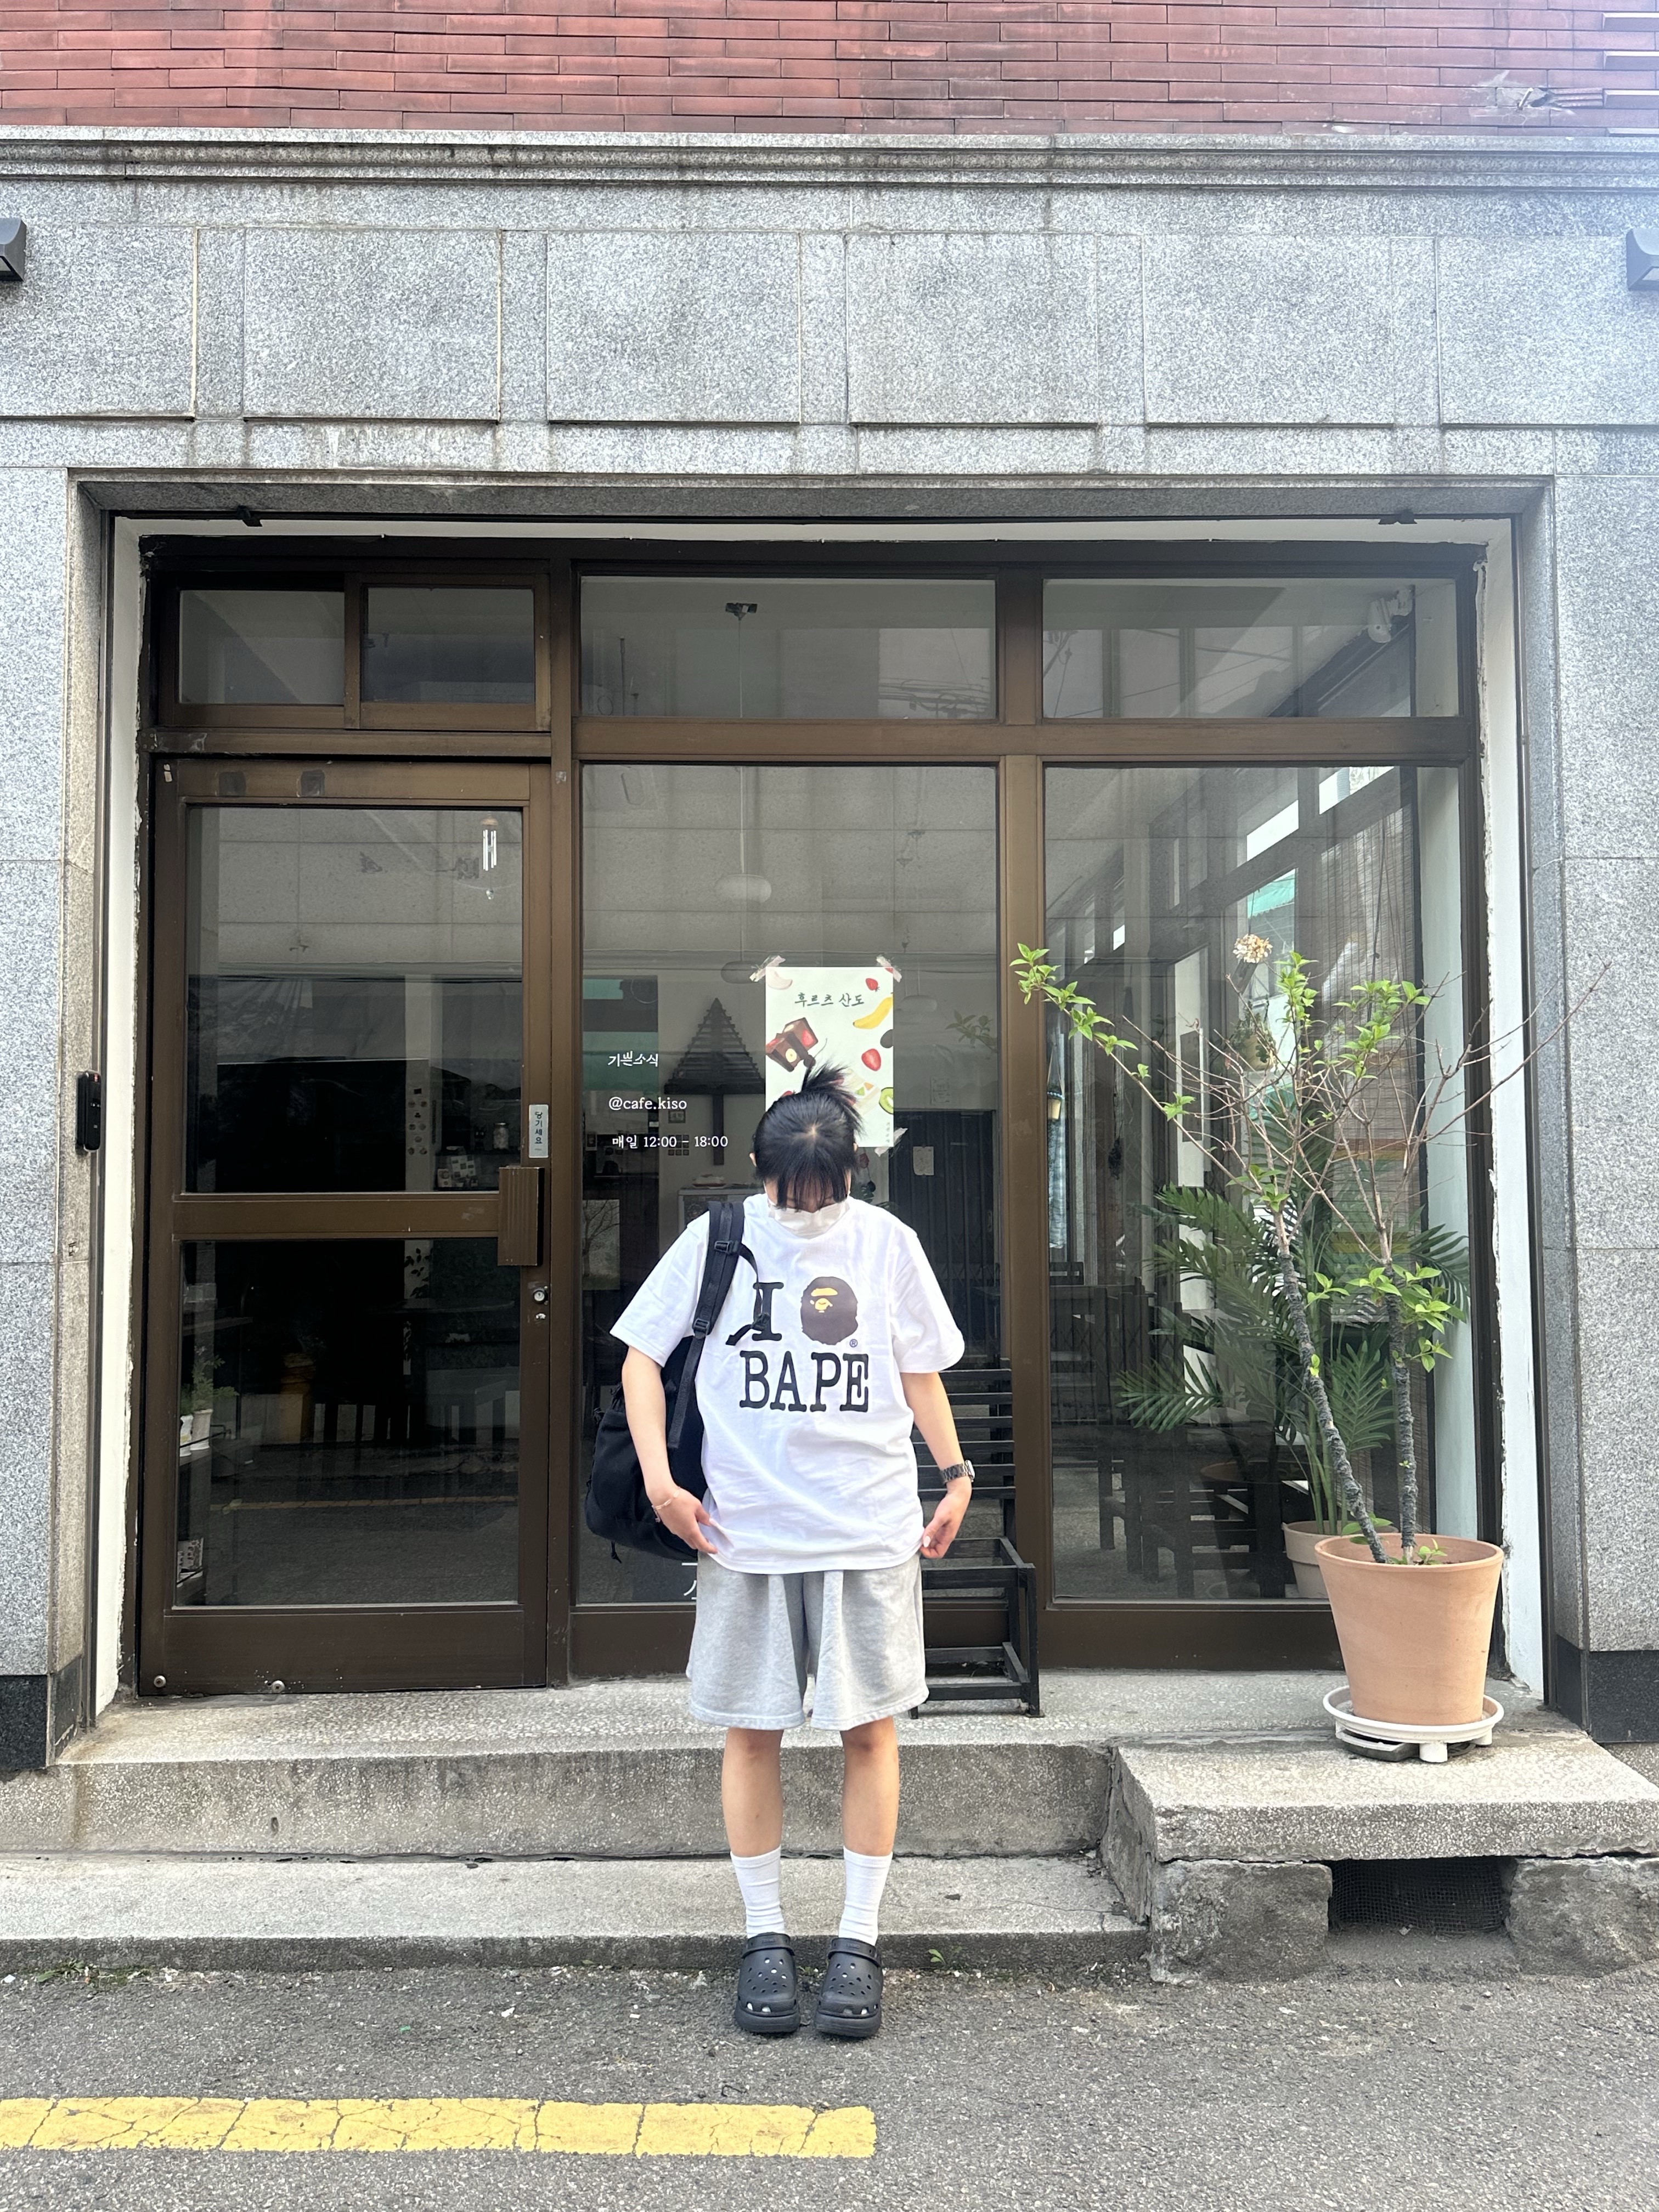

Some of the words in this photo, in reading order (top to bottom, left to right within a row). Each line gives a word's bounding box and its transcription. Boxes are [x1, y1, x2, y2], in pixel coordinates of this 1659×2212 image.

[794, 992, 834, 1007] 후르츠
[839, 992, 865, 1007] 산도
[607, 1051, 658, 1067] 기쁜소식
[608, 1097, 687, 1111] @cafe.kiso
[534, 1111, 543, 1144] 당기세요
[612, 1135, 638, 1149] 매일
[644, 1136, 677, 1147] 12:00
[694, 1136, 729, 1147] 18:00
[752, 1282, 784, 1341] I
[739, 1350, 869, 1413] BAPE
